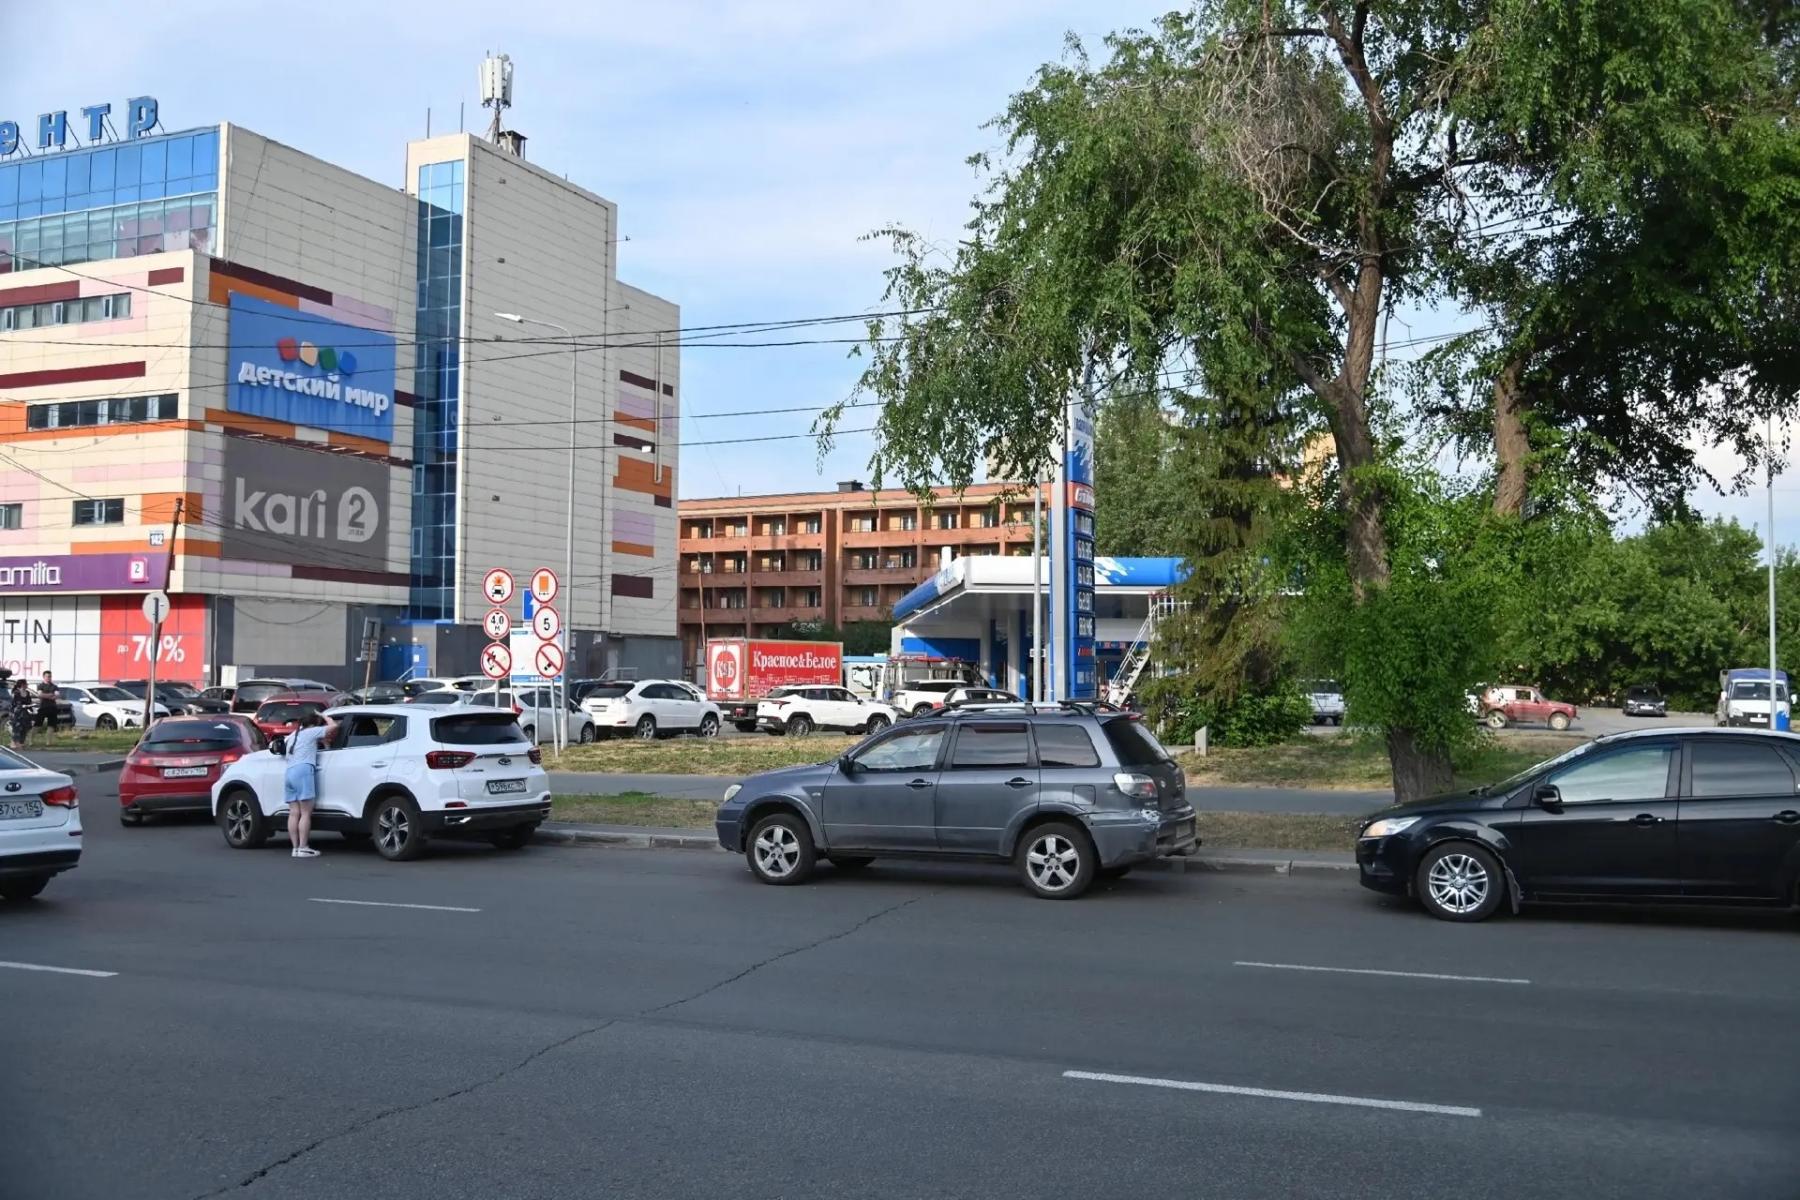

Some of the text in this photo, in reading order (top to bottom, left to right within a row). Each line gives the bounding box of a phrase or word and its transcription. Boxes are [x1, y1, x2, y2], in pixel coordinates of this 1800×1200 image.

[238, 362, 389, 416] Детский мир
[235, 477, 327, 538] kari
[349, 494, 366, 529] 2
[0, 561, 61, 585] amilia
[5, 619, 51, 643] TIN
[543, 617, 551, 631] 5
[132, 635, 185, 663] 70%
